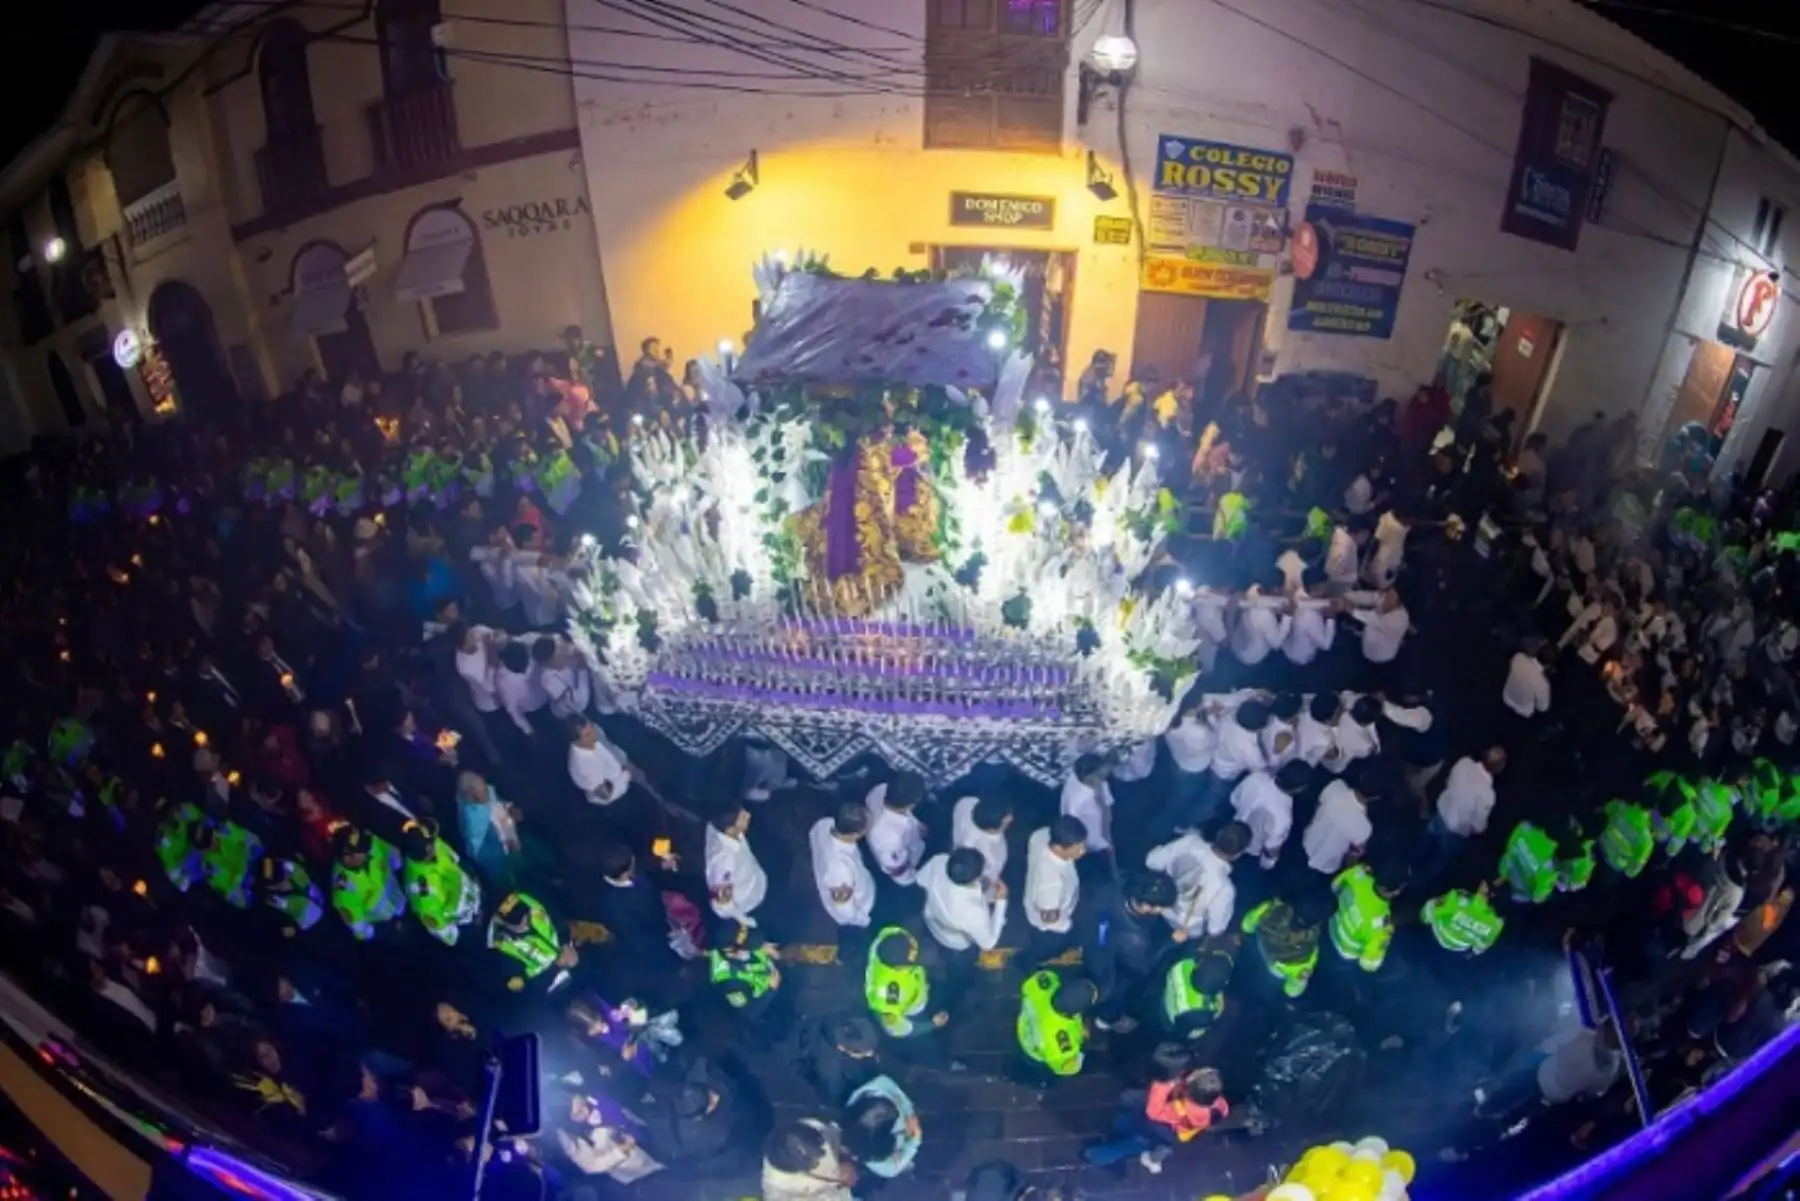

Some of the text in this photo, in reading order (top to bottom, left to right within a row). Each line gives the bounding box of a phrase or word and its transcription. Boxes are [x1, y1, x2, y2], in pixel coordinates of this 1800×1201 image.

[1189, 145, 1290, 174] COLEGIO
[1162, 160, 1288, 201] ROSSY
[482, 196, 589, 230] SAQQARA
[965, 197, 1044, 214] DOMENICO
[983, 211, 1023, 224] SHOP
